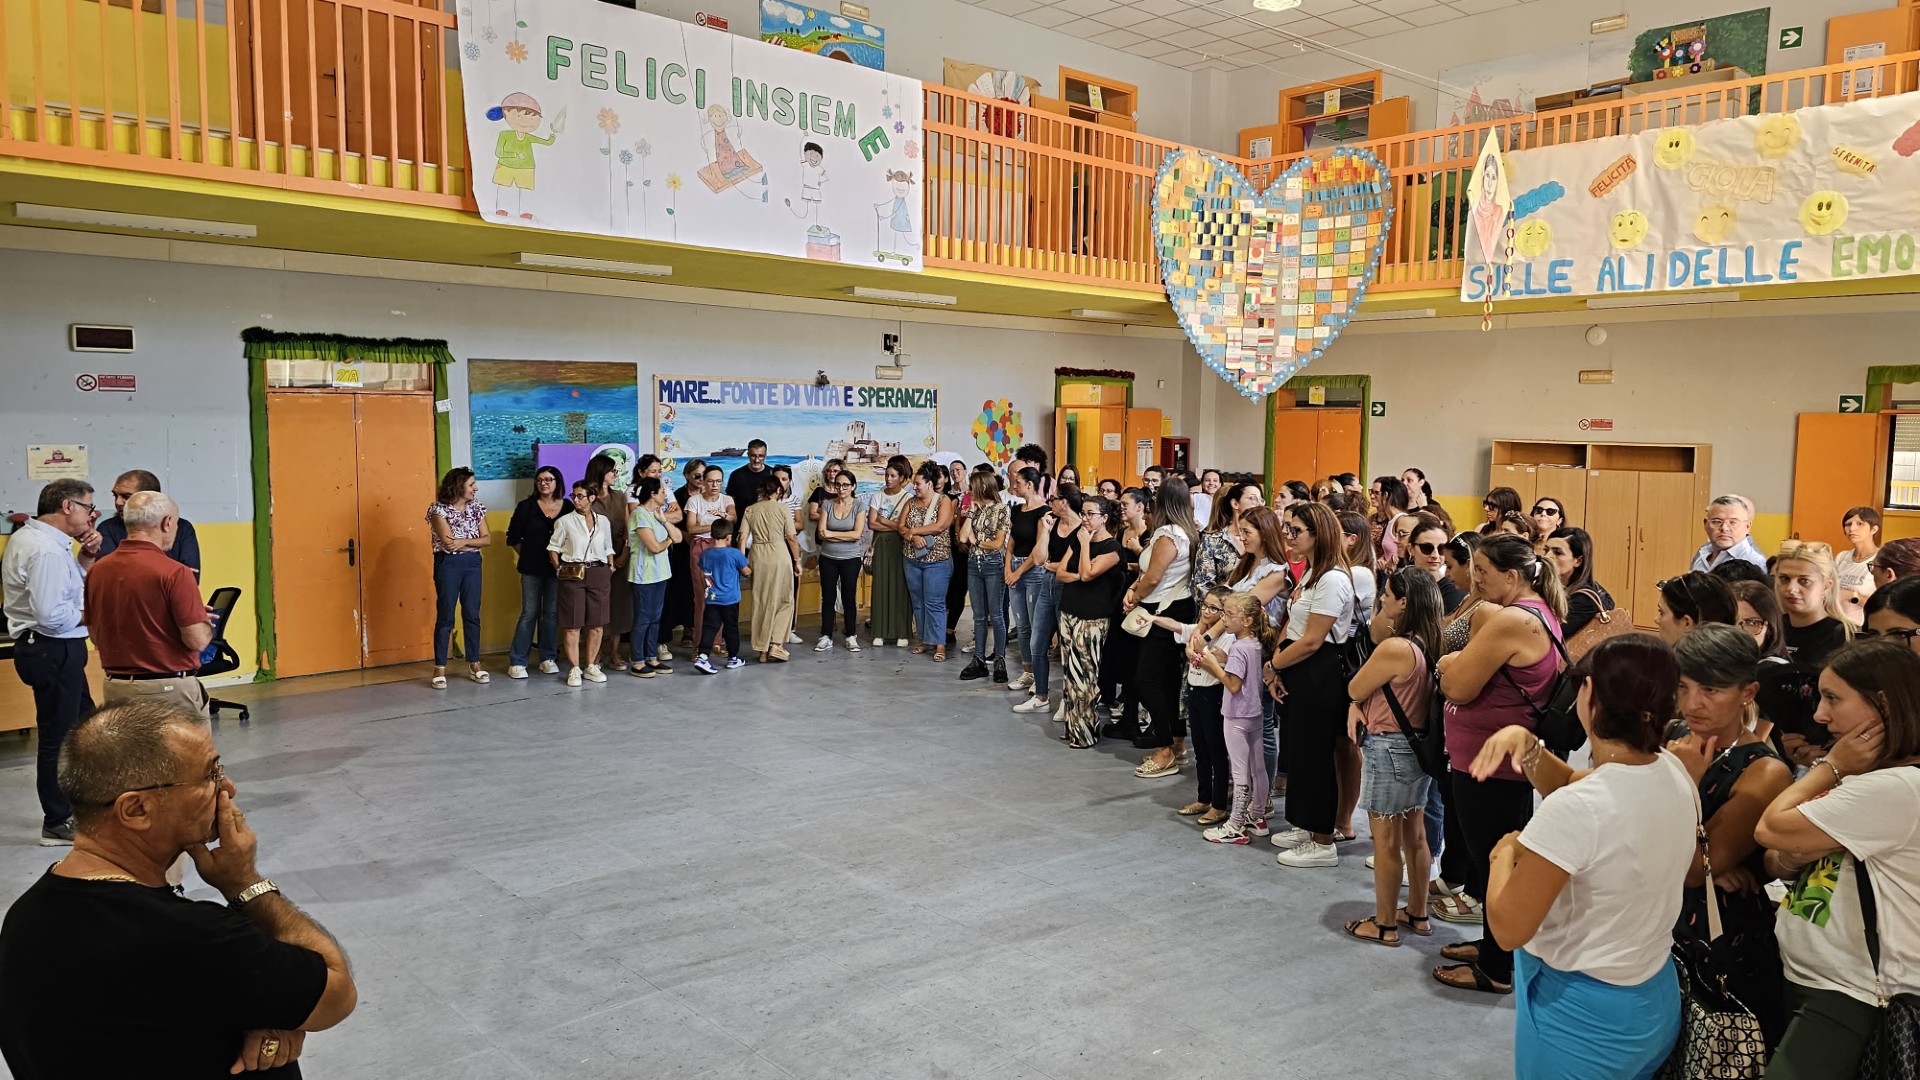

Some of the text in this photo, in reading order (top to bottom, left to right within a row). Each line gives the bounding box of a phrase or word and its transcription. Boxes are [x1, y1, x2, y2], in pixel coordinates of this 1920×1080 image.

[547, 35, 891, 162] FELICI INSIEME
[1596, 253, 1655, 292] ALI
[1668, 241, 1803, 288] DELLE
[720, 381, 779, 406] FONTE
[783, 383, 800, 407] DI
[803, 384, 840, 407] VITA
[844, 386, 854, 407] E
[858, 387, 938, 409] SPERANZA!
